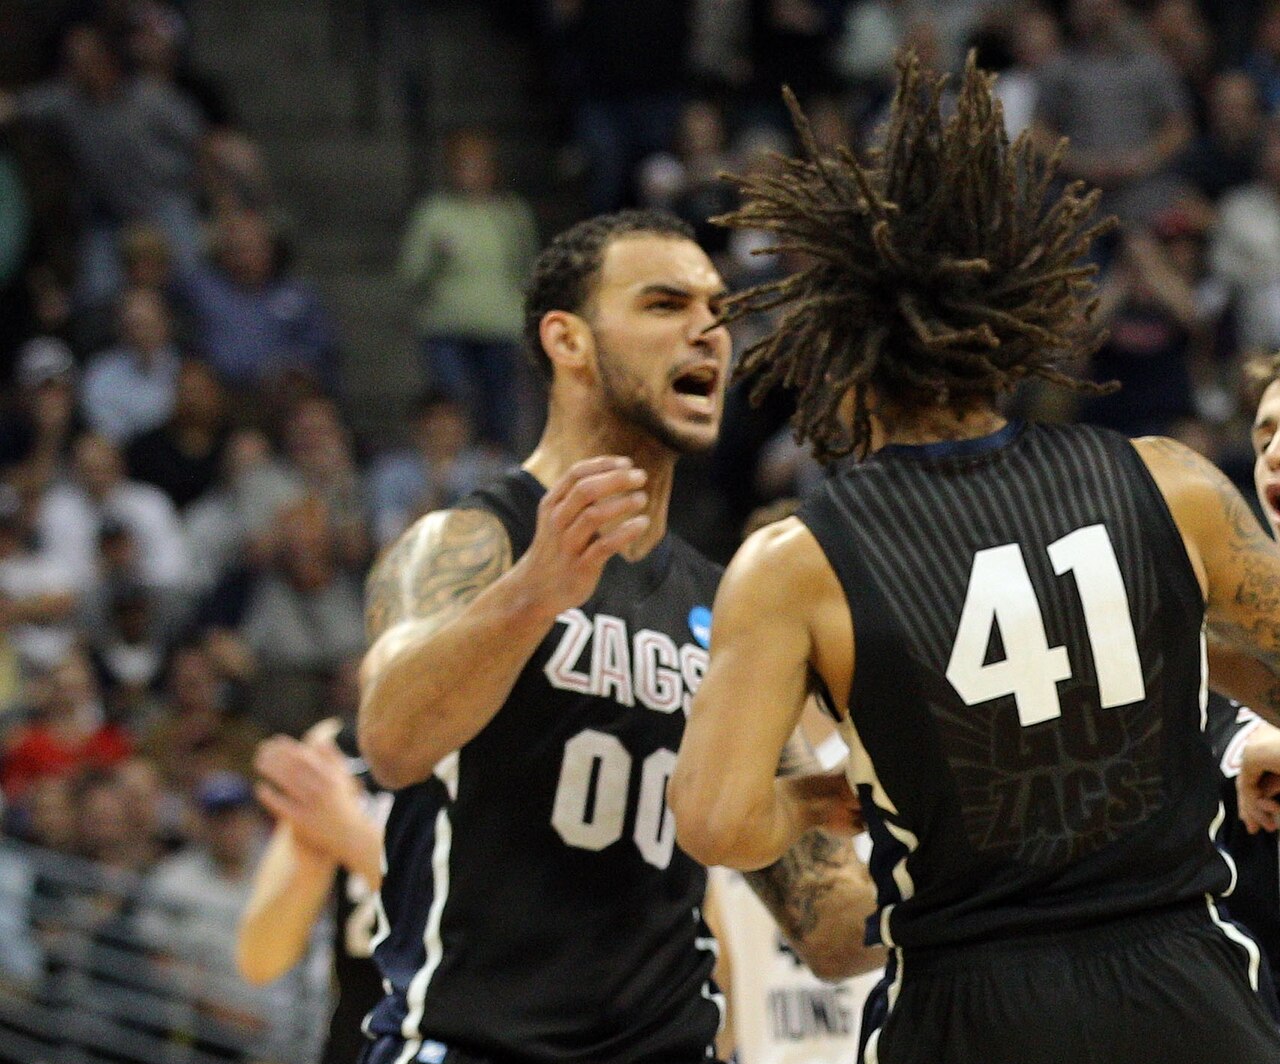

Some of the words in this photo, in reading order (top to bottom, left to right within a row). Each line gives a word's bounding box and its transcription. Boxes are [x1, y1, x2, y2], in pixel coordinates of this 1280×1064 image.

[945, 523, 1147, 728] 41
[551, 728, 678, 871] 00
[978, 758, 1147, 851] ZAGS
